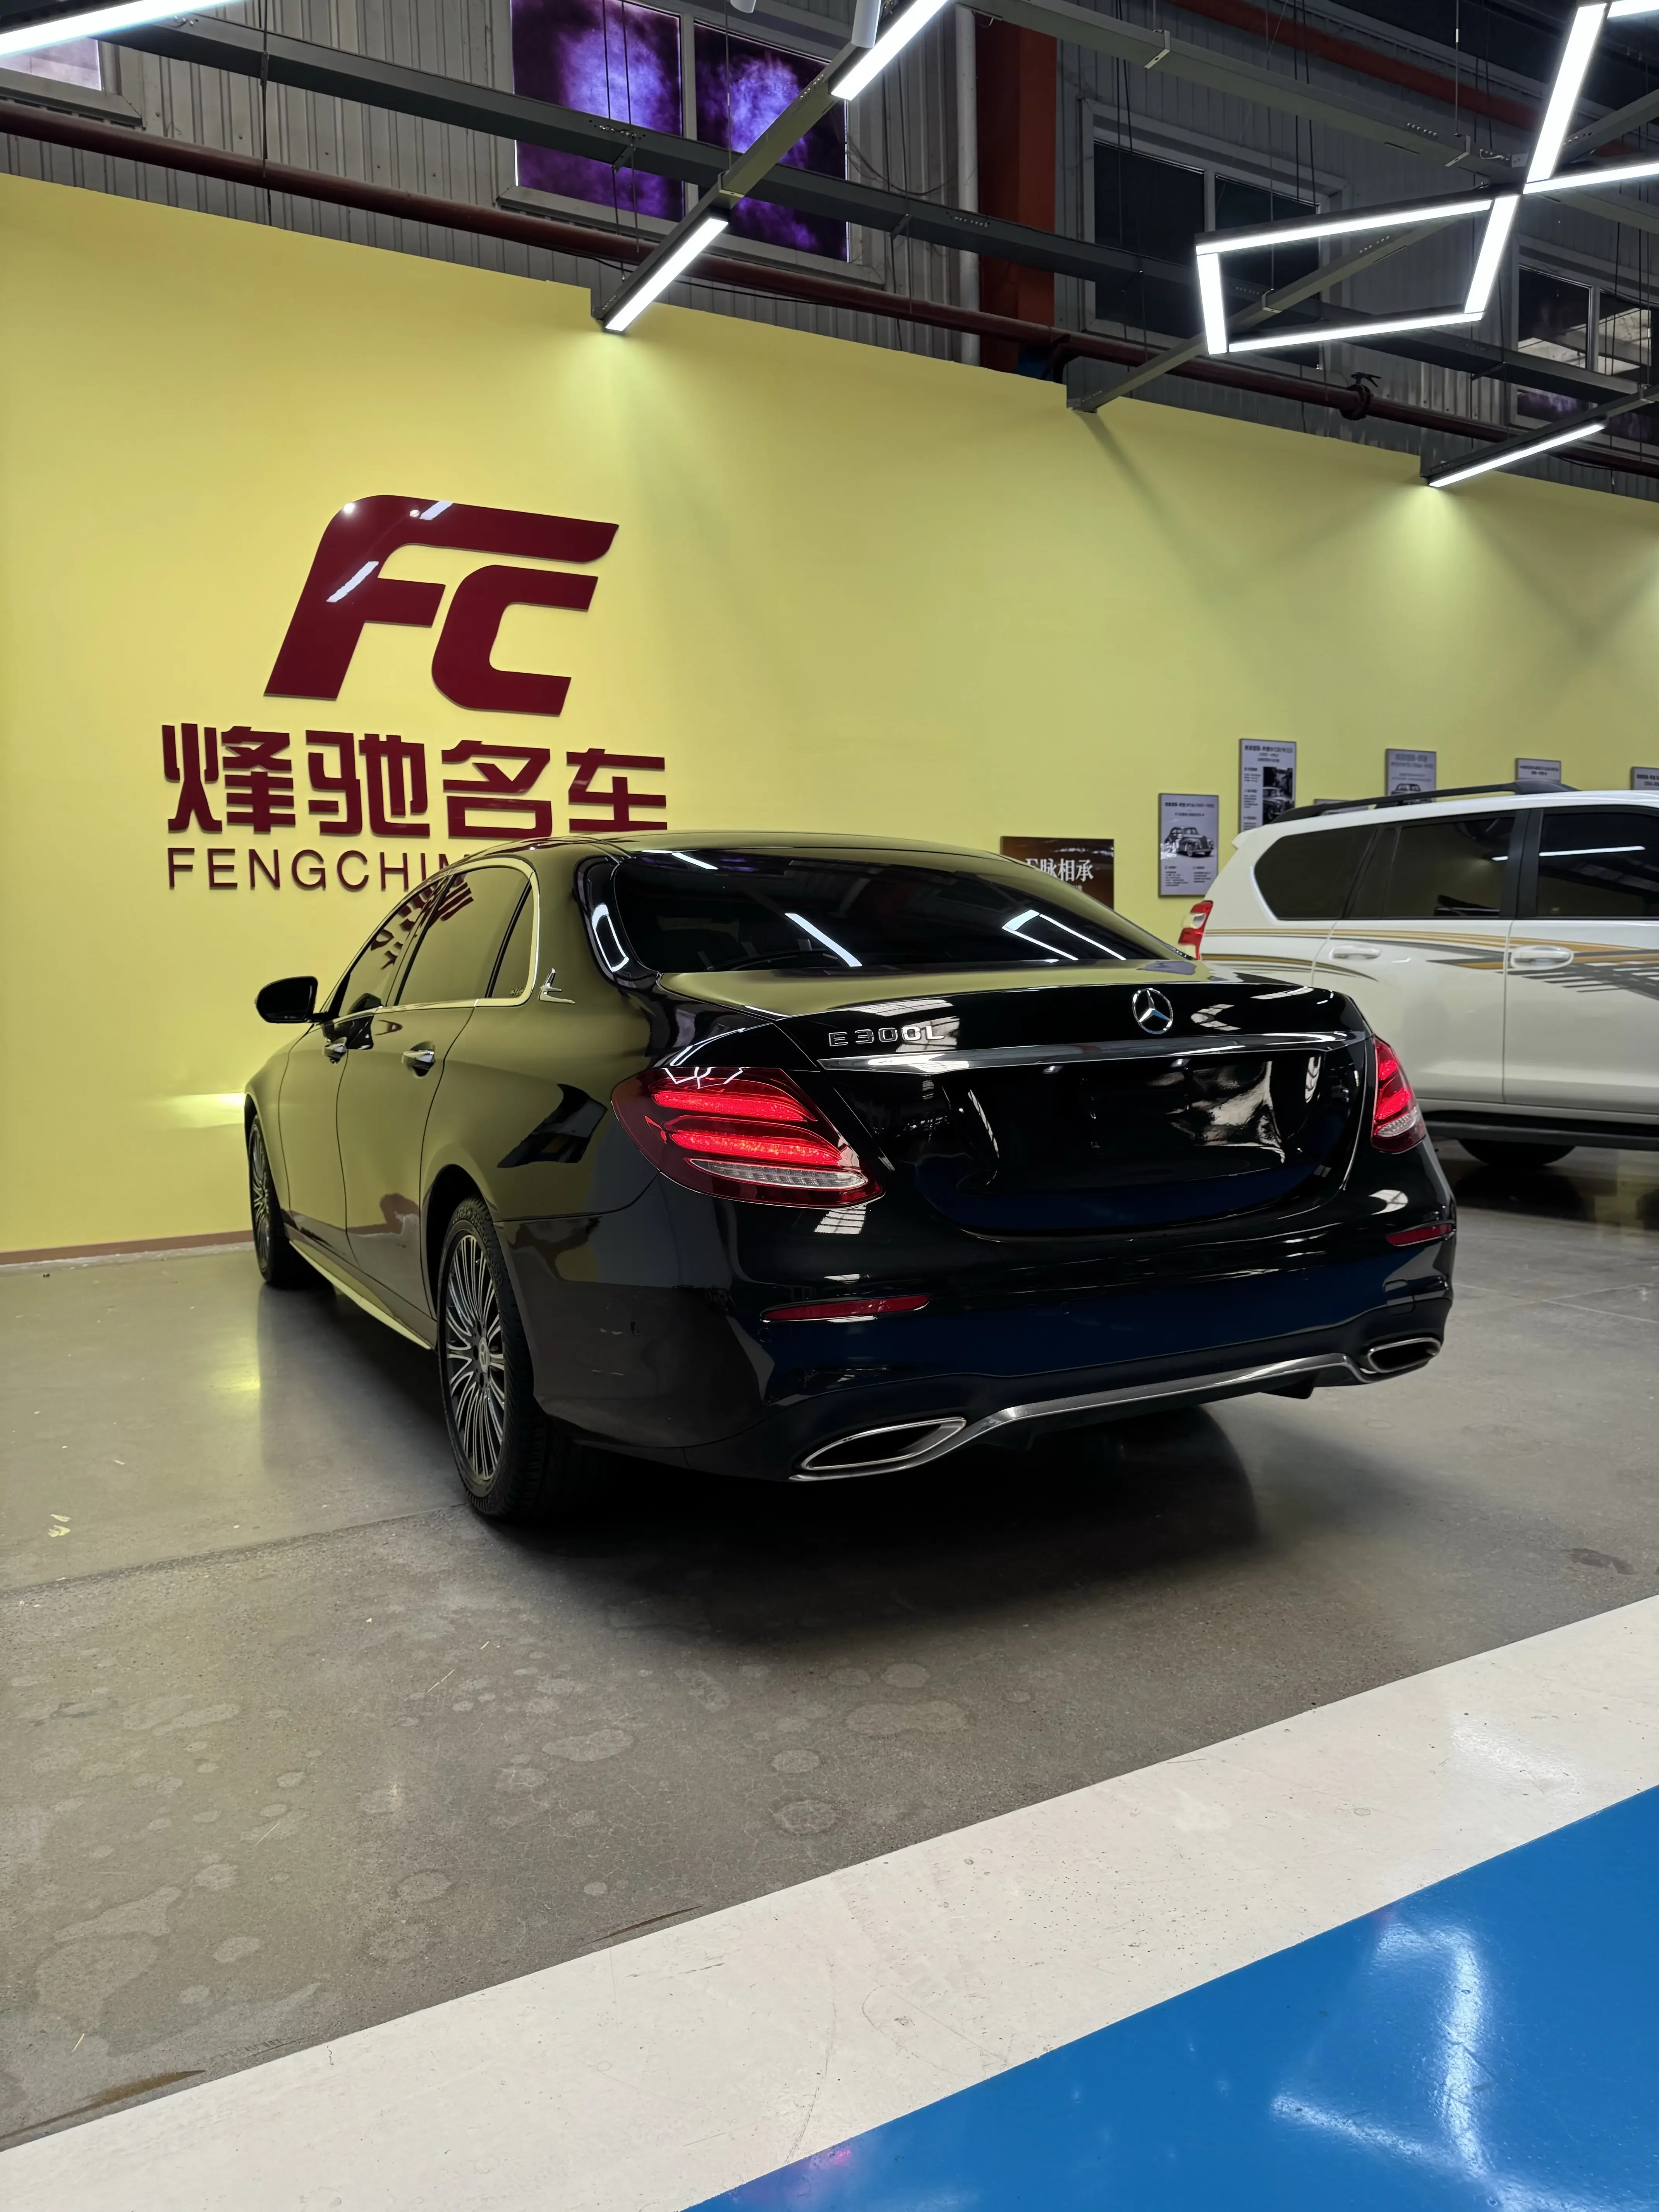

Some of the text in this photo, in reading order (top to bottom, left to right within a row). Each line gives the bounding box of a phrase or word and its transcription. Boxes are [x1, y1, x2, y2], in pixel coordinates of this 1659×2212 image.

[264, 495, 620, 716] FC
[161, 723, 668, 839] 烽驰名车
